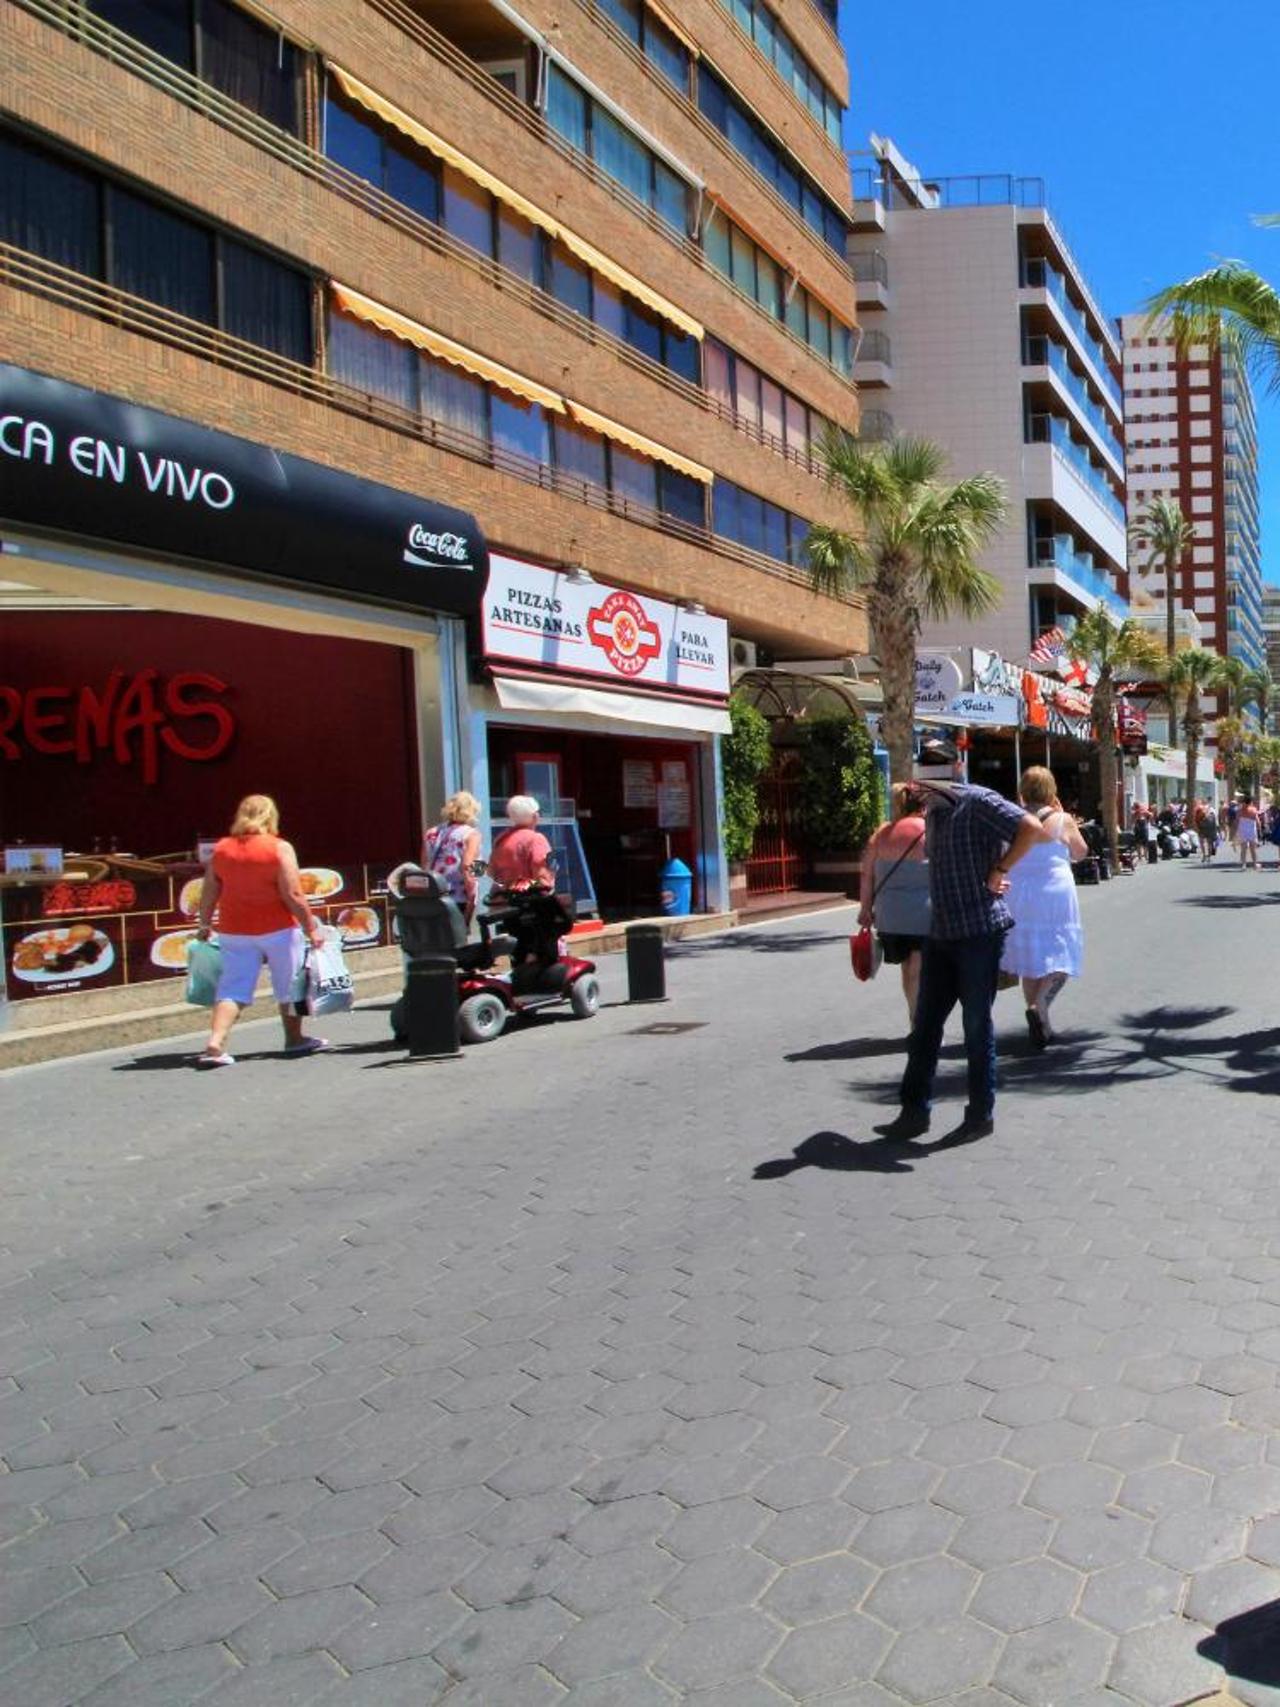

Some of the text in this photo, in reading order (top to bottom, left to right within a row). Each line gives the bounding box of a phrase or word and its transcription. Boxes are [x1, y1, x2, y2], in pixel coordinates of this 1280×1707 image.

[0, 415, 234, 510] CA EN VIVO
[507, 587, 563, 614] PIZZAS
[491, 605, 583, 638] ARTESANAS
[680, 630, 709, 649] PARA
[609, 649, 645, 672] PIZZA
[676, 645, 715, 666] LLEVAR
